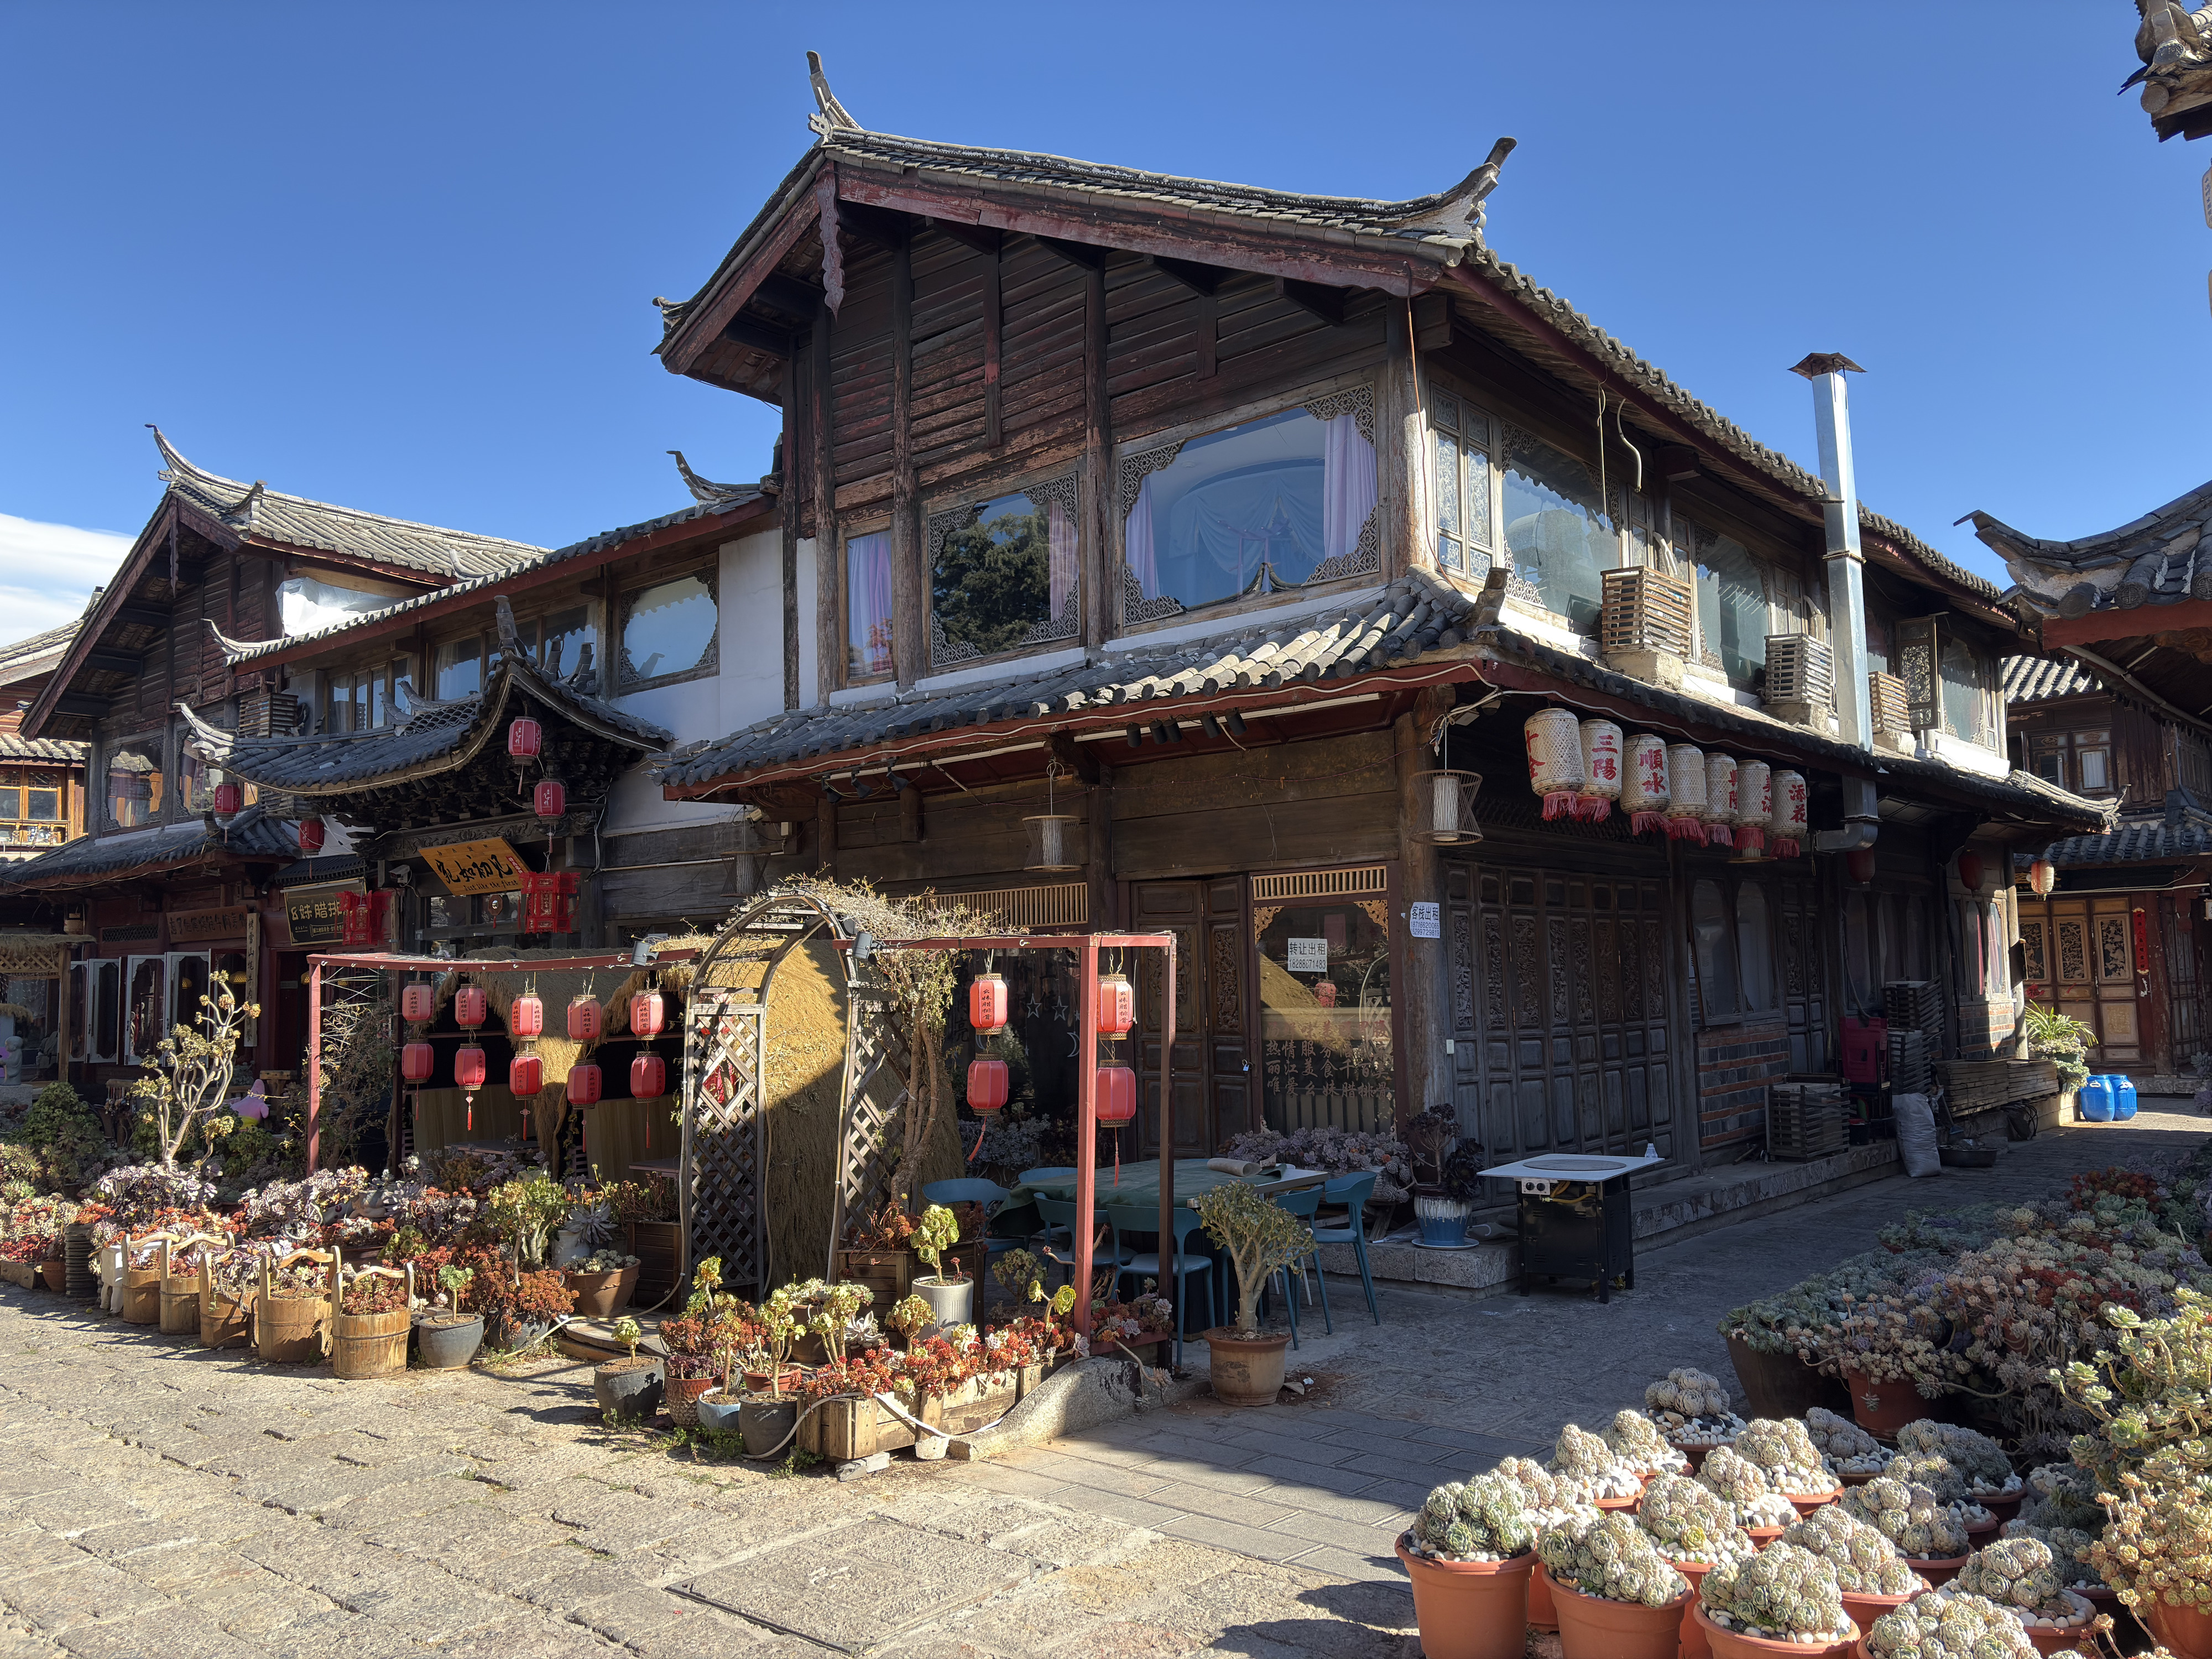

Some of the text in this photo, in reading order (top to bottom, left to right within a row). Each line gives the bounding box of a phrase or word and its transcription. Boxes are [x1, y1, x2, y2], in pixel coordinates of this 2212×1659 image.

[1592, 734, 1618, 780] 三陽
[1639, 748, 1666, 794] 順水
[1788, 784, 1807, 823] 添花
[501, 879, 518, 889] first
[290, 900, 353, 920] 幺妹腊排
[1412, 905, 1438, 921] 客栈出租
[1411, 921, 1439, 929] 18716620065
[1290, 942, 1326, 956] 转让出租
